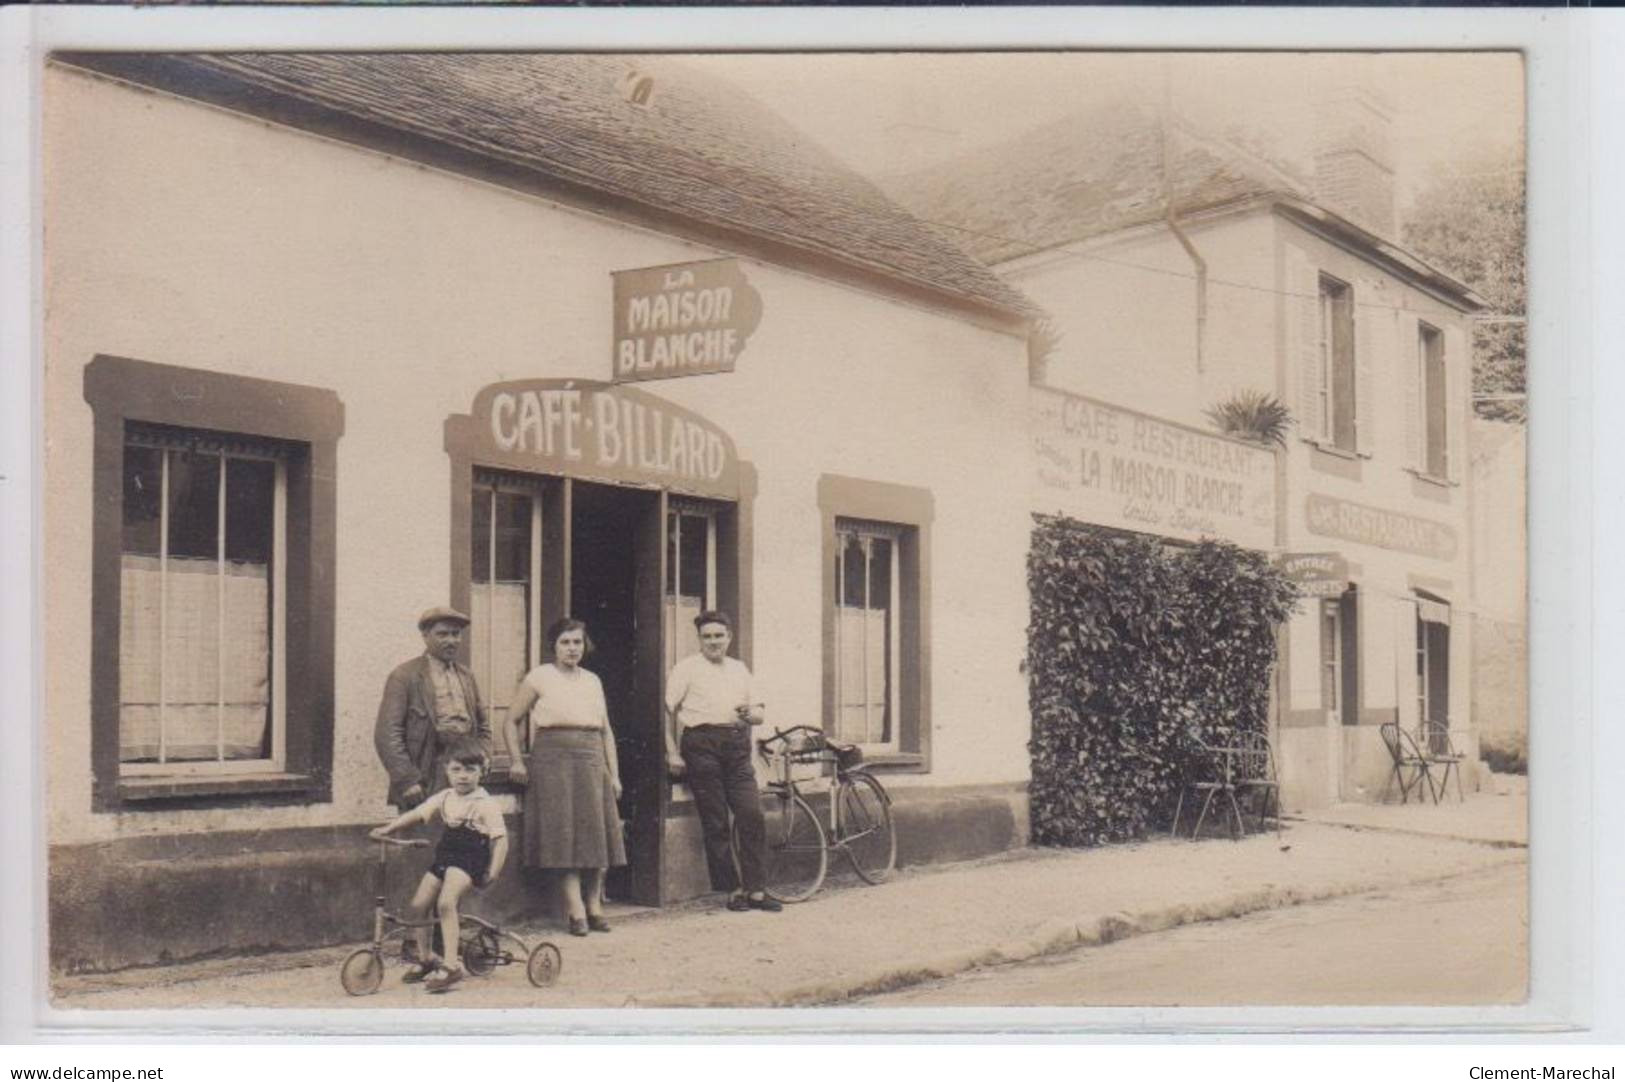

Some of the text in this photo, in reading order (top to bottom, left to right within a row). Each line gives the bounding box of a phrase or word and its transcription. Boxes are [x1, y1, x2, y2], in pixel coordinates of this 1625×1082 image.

[664, 270, 696, 290] LA
[628, 287, 733, 334] MAISON
[618, 328, 737, 375] BLANCHE
[1133, 417, 1254, 476] RESTAURANT
[1081, 448, 1101, 488] LA
[1111, 456, 1177, 505] MAISON
[1185, 472, 1244, 517] BLANCHE
[1339, 501, 1433, 550] RESTAURANT
